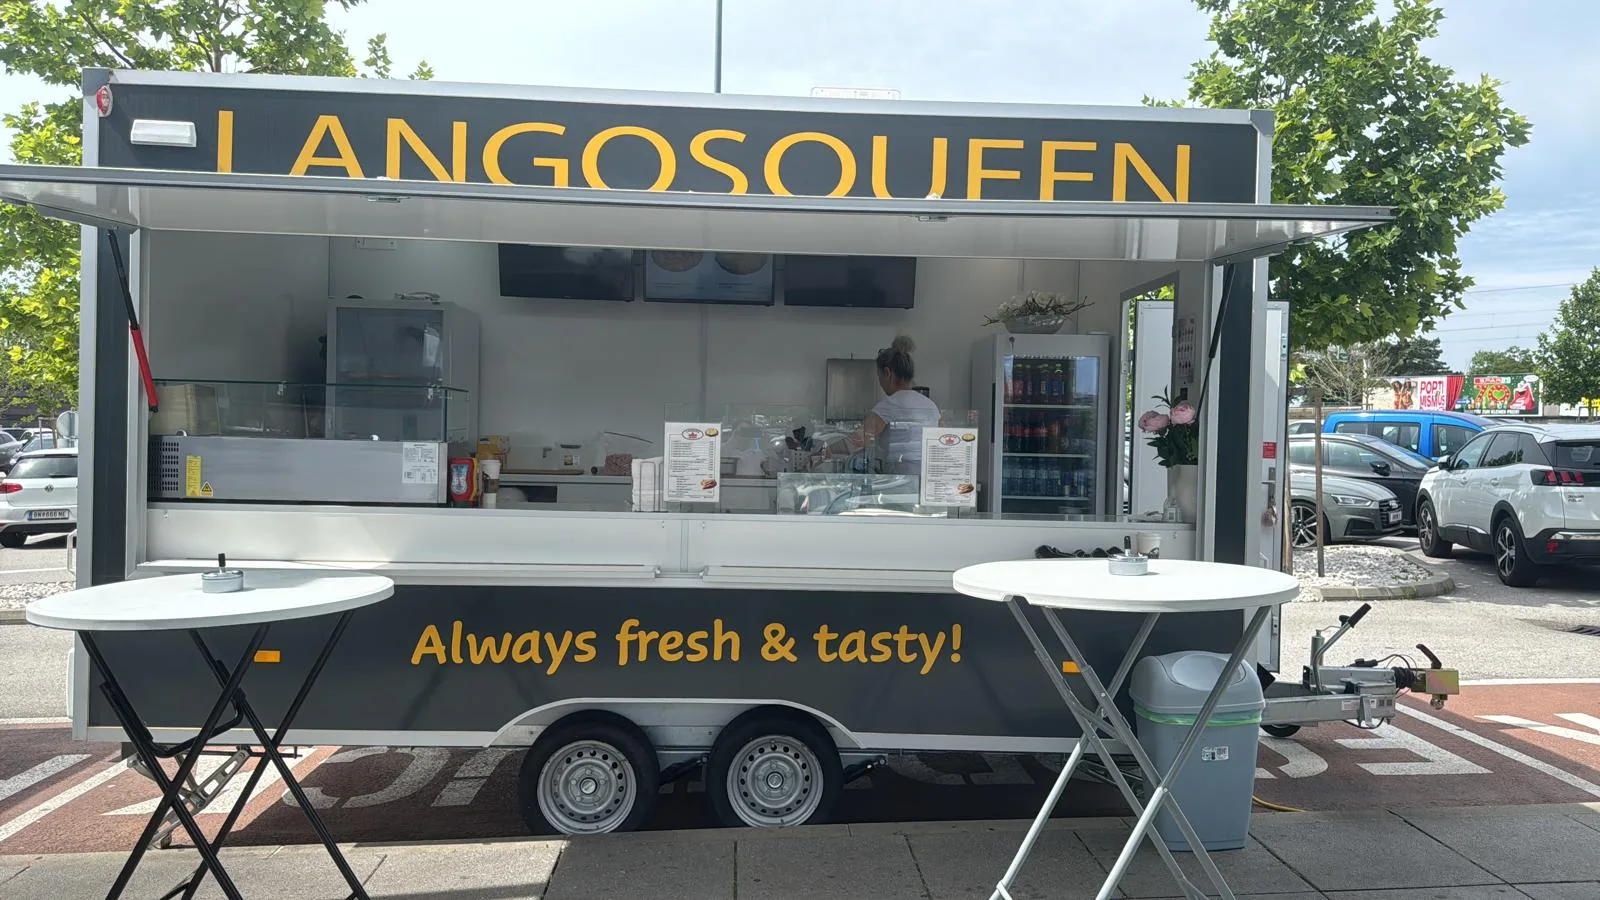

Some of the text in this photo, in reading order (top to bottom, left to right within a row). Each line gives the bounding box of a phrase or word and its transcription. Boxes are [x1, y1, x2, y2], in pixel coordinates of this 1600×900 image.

[410, 618, 962, 676] Always fresh & tasty!
